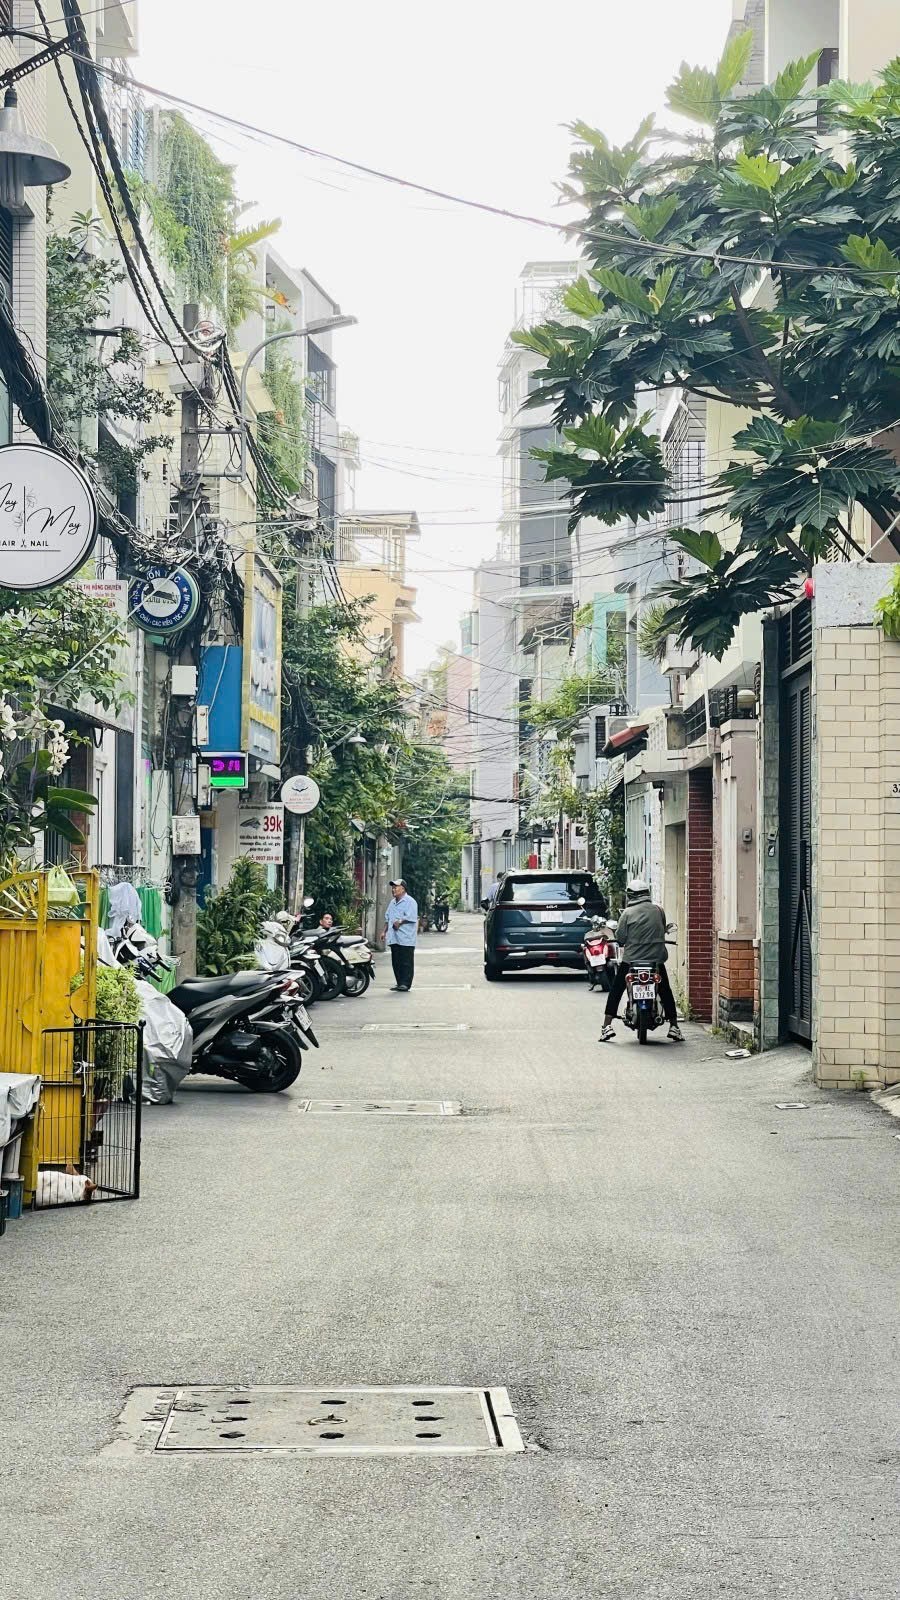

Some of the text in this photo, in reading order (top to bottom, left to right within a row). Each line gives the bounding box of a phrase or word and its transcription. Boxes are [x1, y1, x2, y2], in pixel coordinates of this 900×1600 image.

[0, 483, 17, 512] ay
[27, 505, 81, 535] May
[892, 783, 900, 793] 3
[263, 815, 282, 832] 39k
